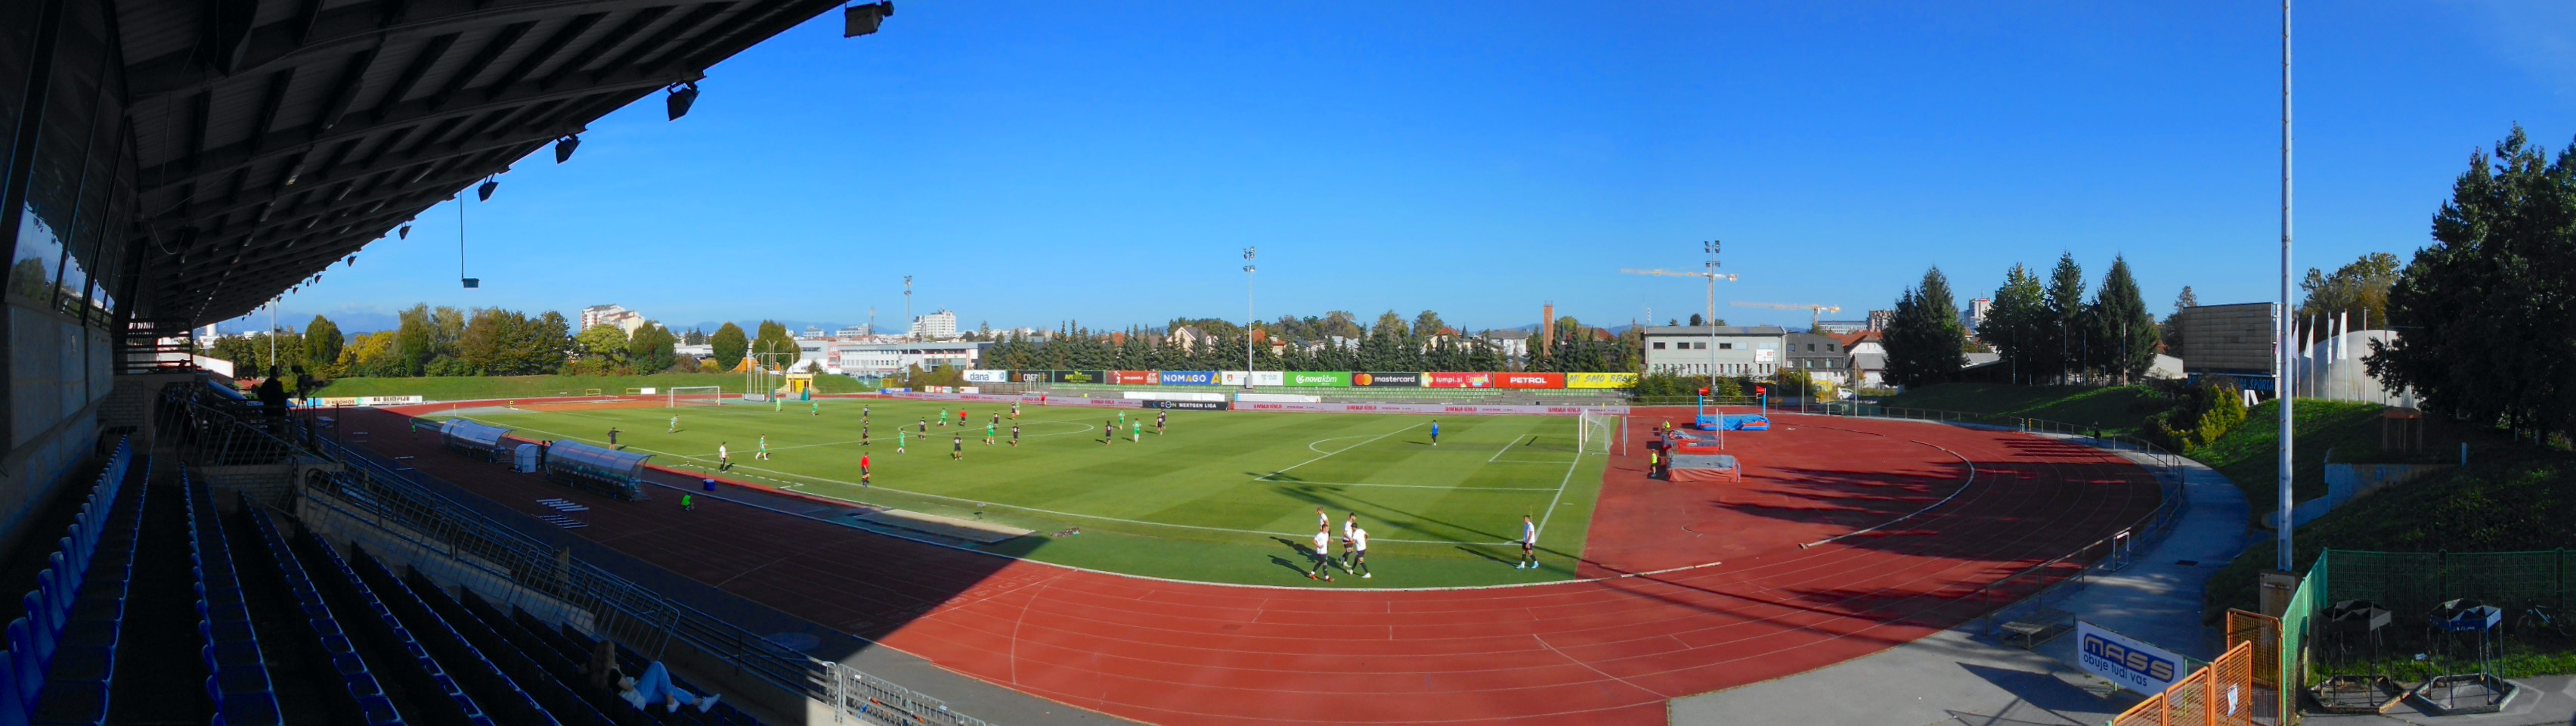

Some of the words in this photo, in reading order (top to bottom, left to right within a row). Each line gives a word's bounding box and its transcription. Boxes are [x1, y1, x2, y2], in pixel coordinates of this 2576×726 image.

[970, 373, 989, 381] dana
[1568, 374, 1581, 383] MI
[1584, 374, 1605, 383] SMO
[2085, 635, 2173, 681] MASS
[2083, 653, 2109, 672] obuje
[2130, 672, 2147, 687] vas
